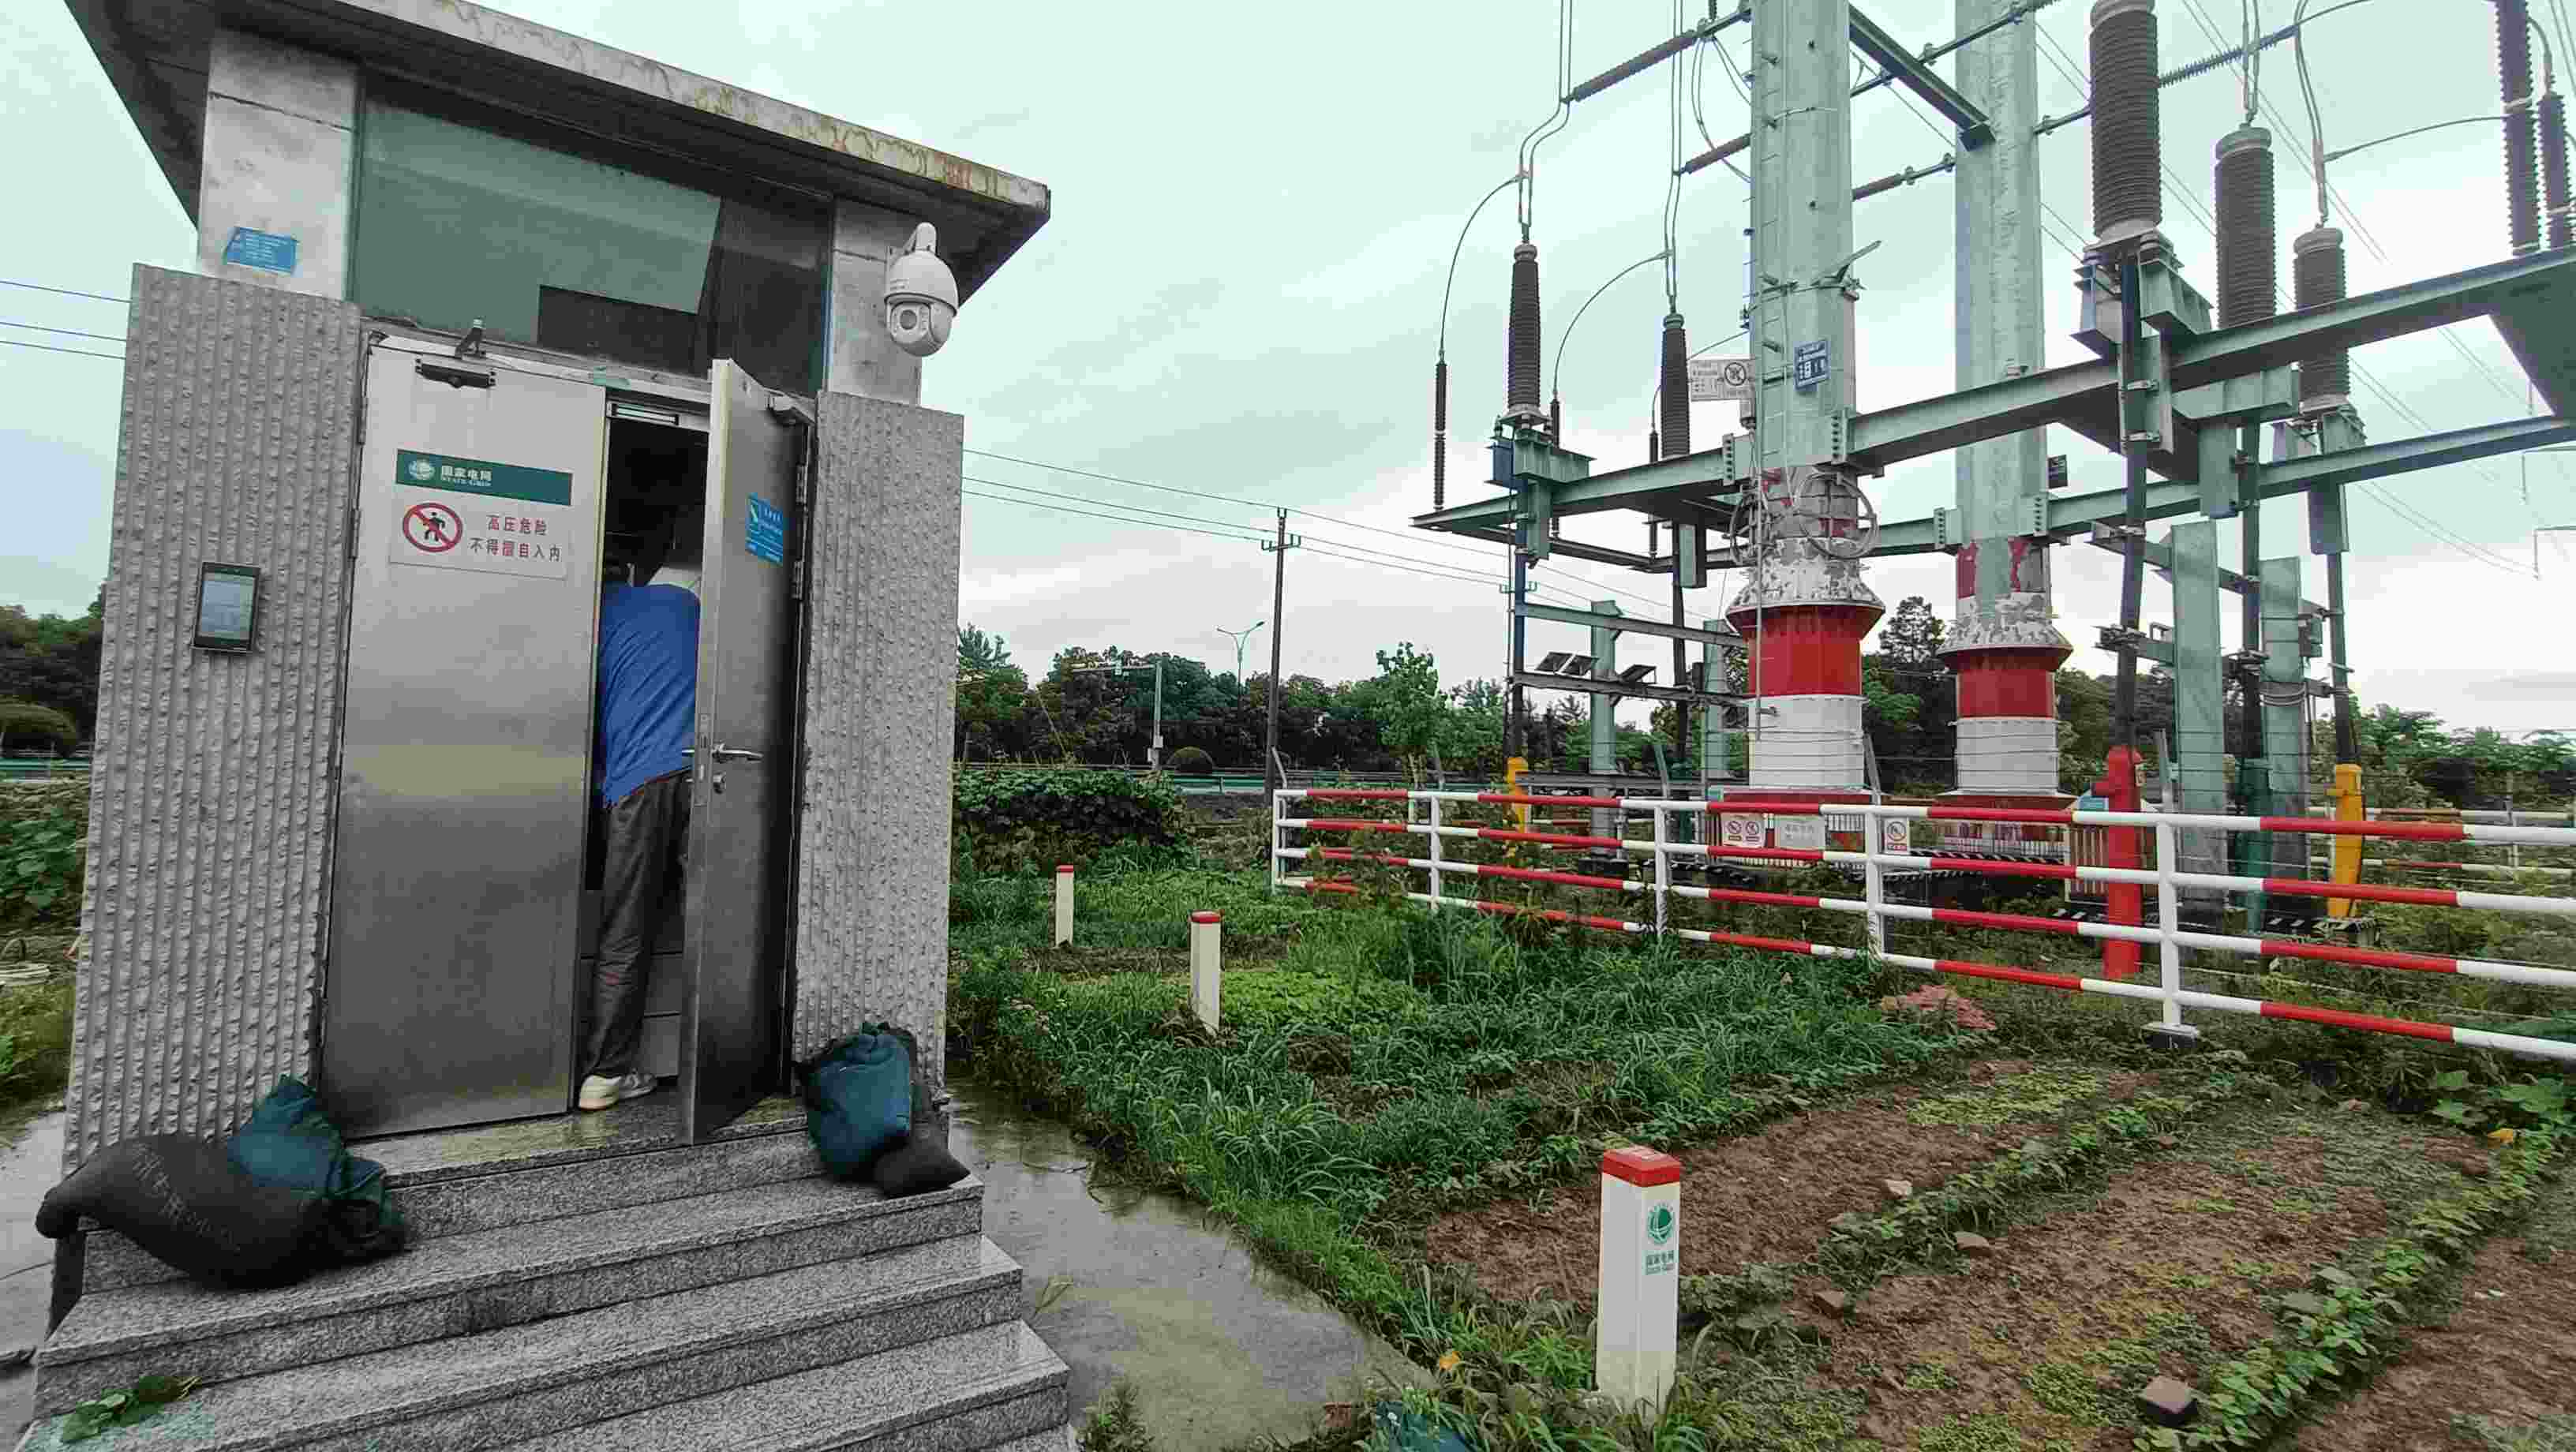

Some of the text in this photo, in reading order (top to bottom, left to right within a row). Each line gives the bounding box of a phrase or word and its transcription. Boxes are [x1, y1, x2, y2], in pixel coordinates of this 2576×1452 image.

[441, 466, 492, 481] 国家电网
[486, 515, 548, 536] 高压危险
[470, 537, 562, 562] 不得擅自入内
